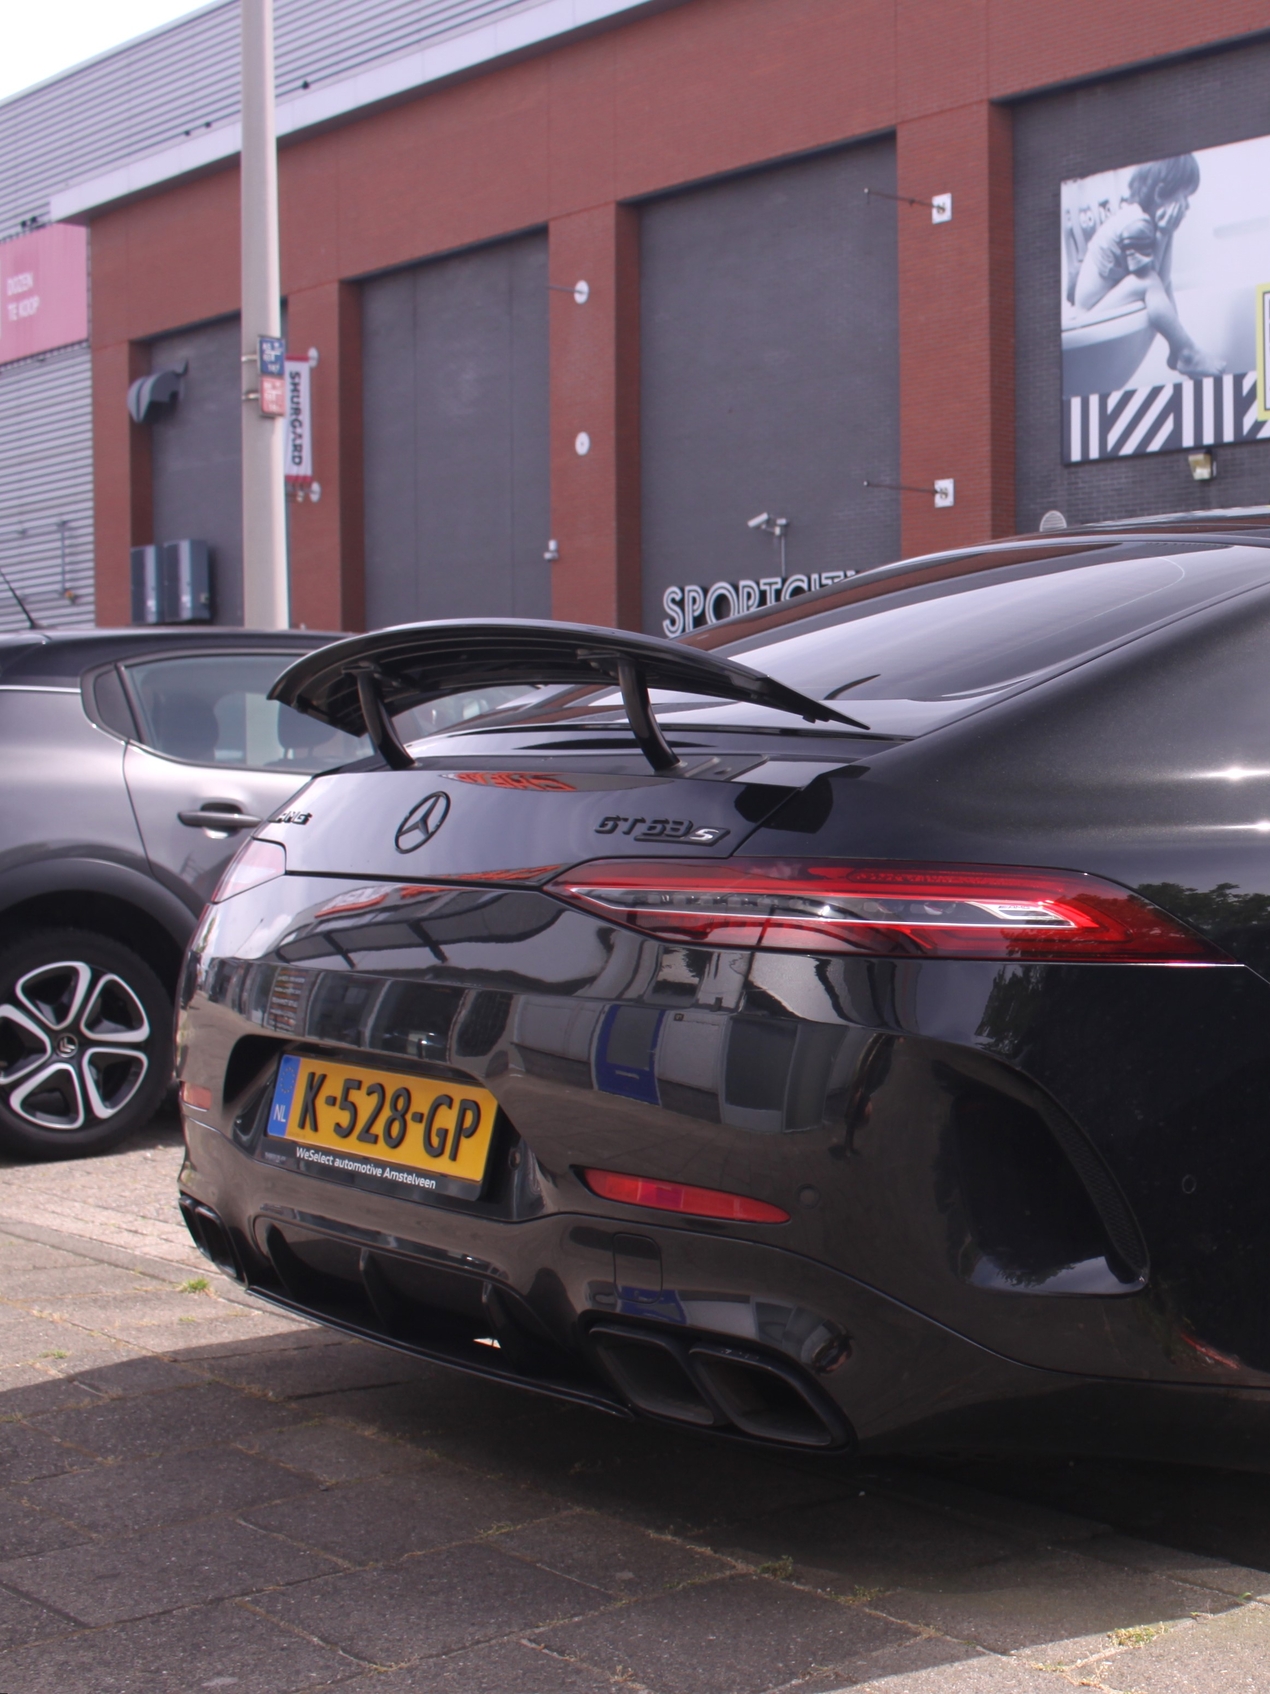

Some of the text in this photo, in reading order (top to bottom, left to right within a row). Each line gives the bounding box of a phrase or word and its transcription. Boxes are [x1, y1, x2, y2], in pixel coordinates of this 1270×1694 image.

[289, 371, 303, 466] SHURGARD
[663, 571, 857, 638] SPORTC
[272, 1103, 286, 1123] NL
[298, 1071, 482, 1162] K-528-GP
[296, 1146, 334, 1166] WeSelect
[334, 1156, 382, 1178] automotive
[382, 1166, 436, 1190] Amstelveen
